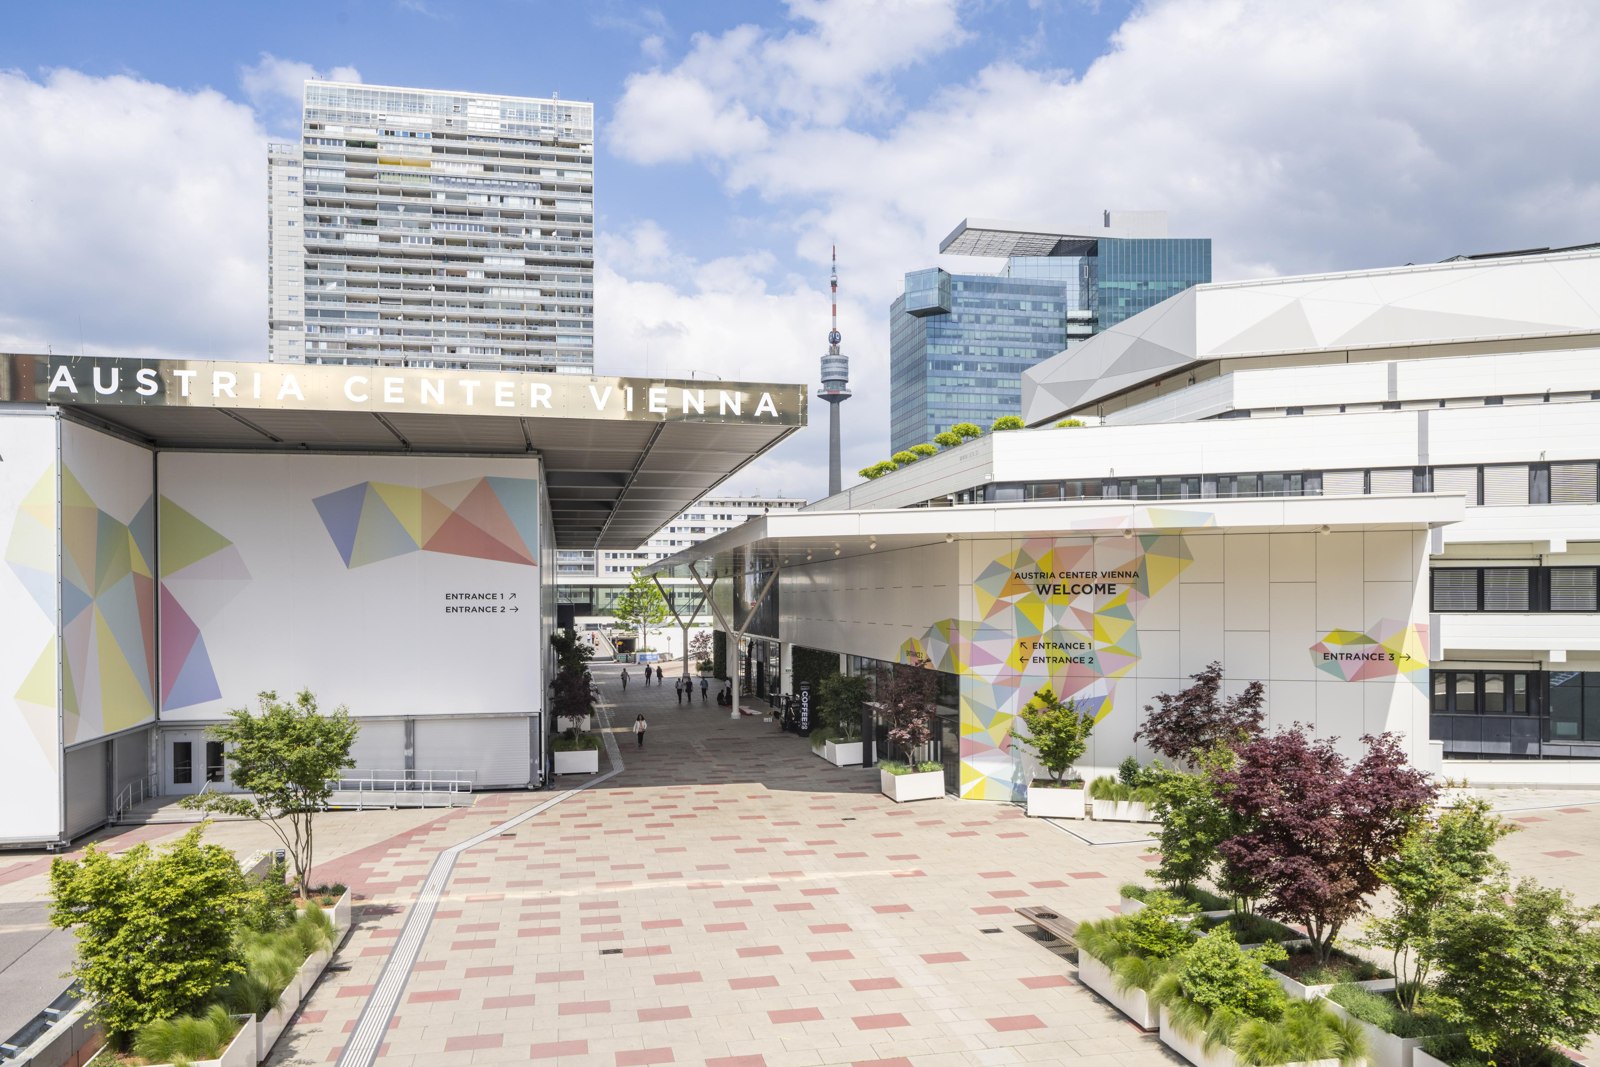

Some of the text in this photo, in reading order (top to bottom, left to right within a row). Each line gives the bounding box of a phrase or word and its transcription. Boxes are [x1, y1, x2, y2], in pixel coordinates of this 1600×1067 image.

[48, 365, 779, 417] AUSTRIA CENTER VIENNA
[1014, 571, 1140, 580] AUSTRIA CENTER VIENNA
[1036, 584, 1117, 595] WELCOME
[1032, 642, 1092, 650] ENTRANCE 1
[1032, 656, 1094, 664] ENTRANCE 2
[1323, 652, 1395, 661] ENTRANCE 3
